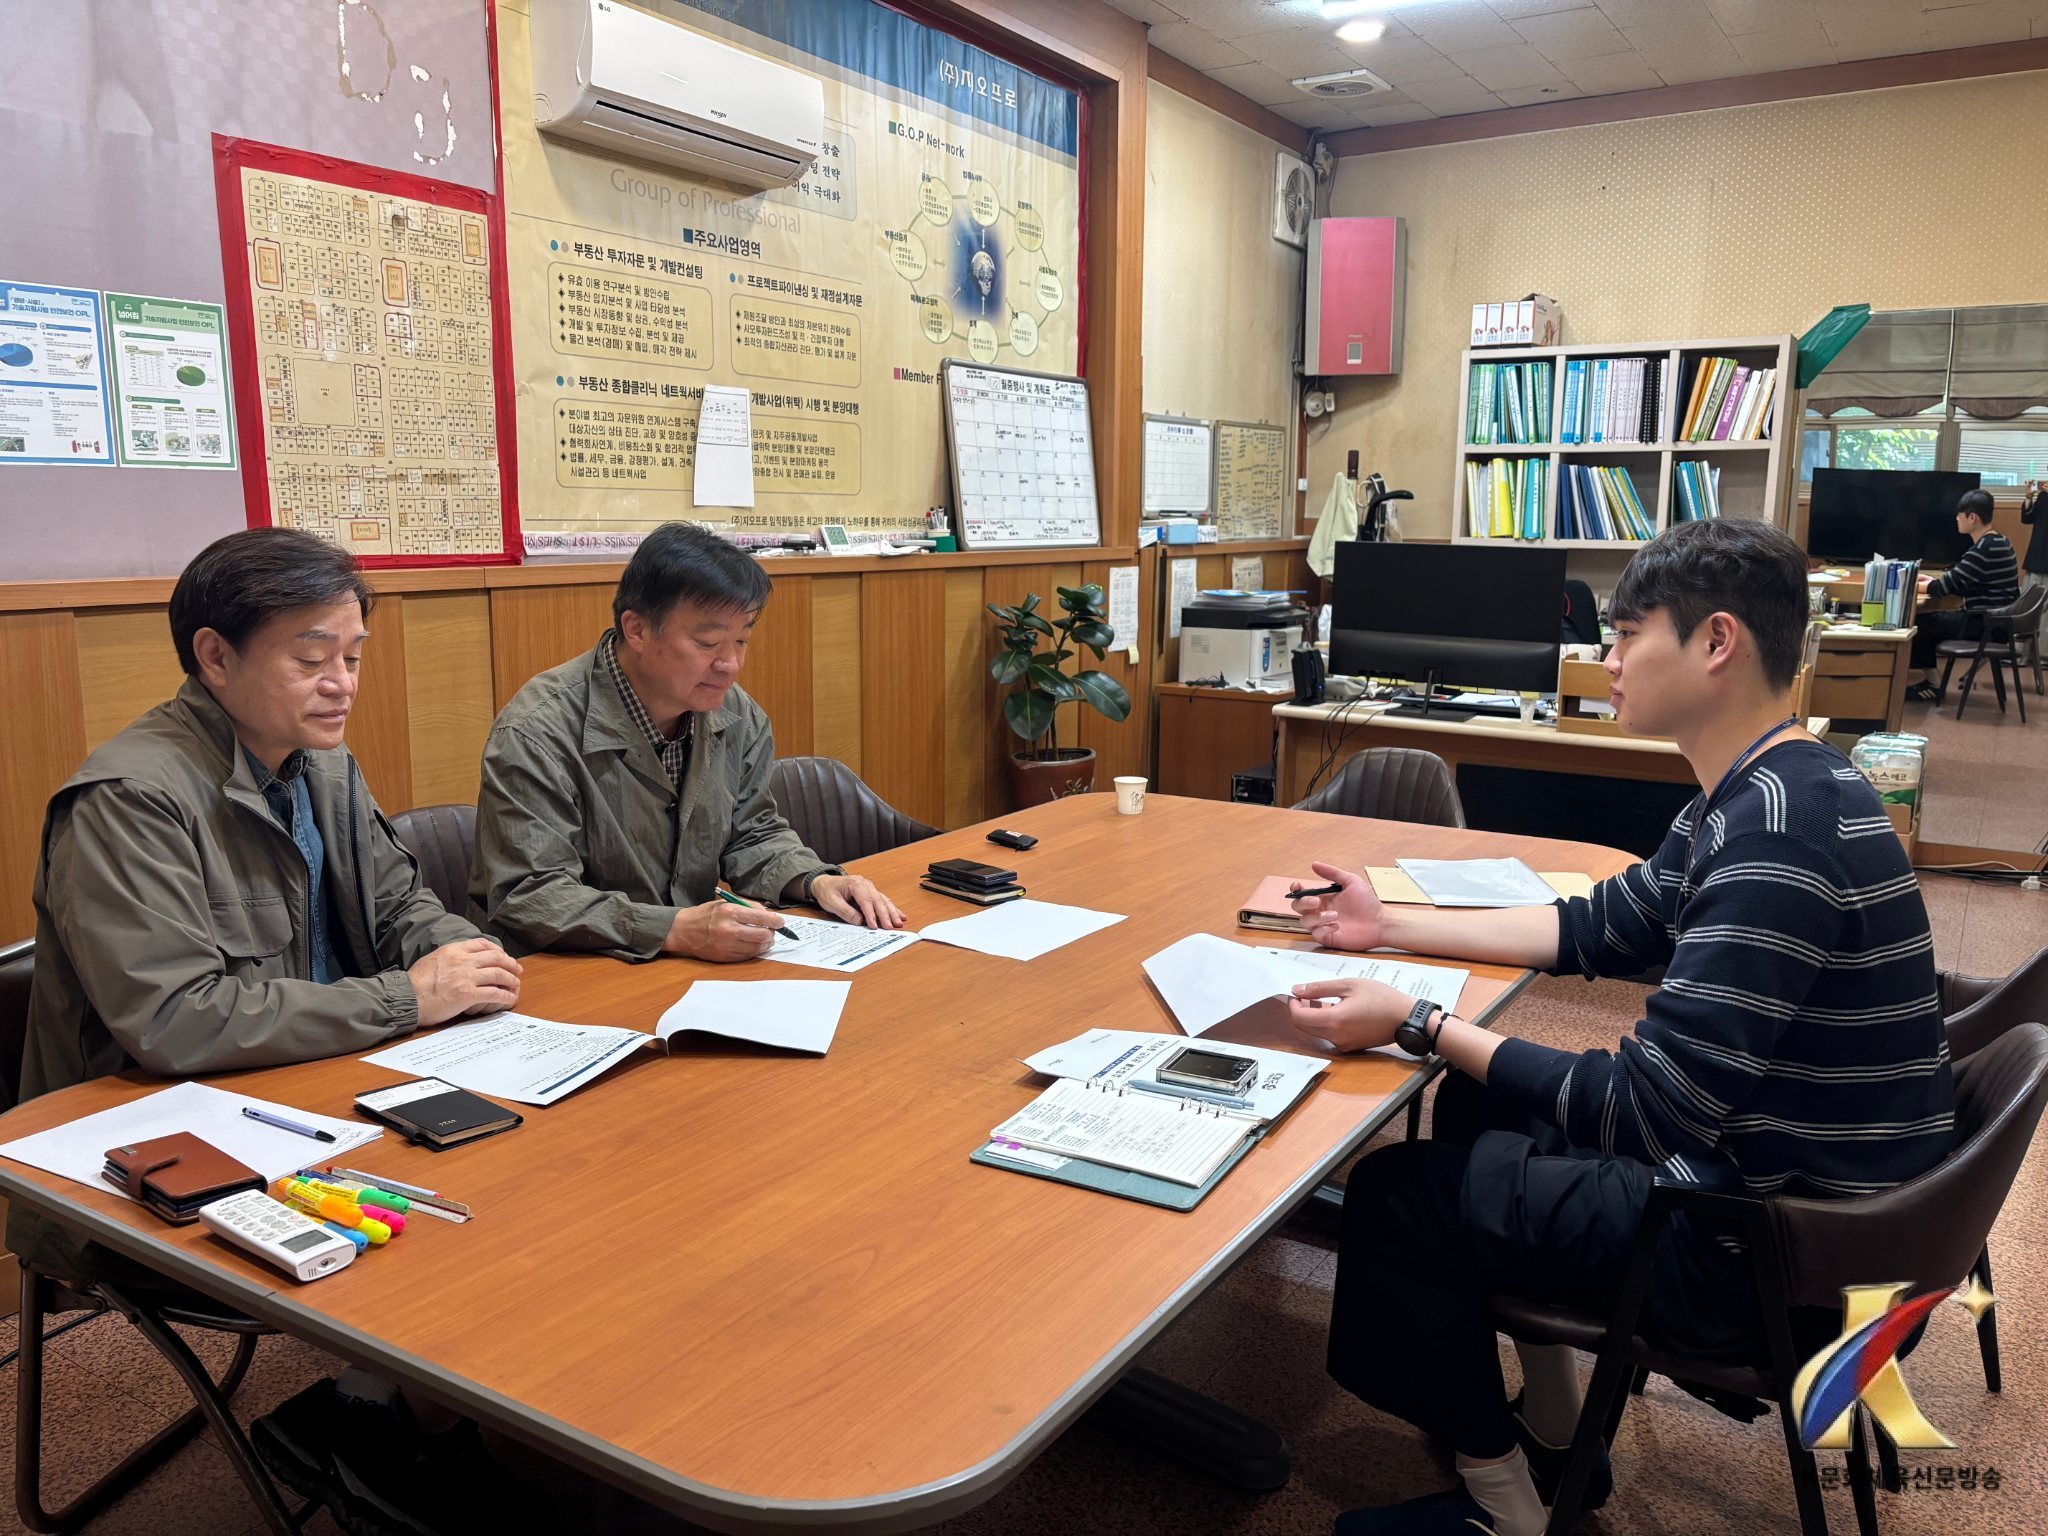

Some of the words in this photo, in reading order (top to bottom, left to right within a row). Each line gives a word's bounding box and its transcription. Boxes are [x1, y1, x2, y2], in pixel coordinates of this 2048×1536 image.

[940, 58, 1017, 109] (주)지오프로
[897, 123, 924, 143] G.O.P
[926, 133, 965, 158] Net-work
[821, 142, 840, 158] 창출
[822, 165, 841, 181] 전략
[609, 168, 672, 207] Group
[678, 188, 699, 209] of
[702, 190, 801, 233] Professional
[813, 185, 841, 203] 극대화
[694, 228, 761, 259] 주요사업영역
[573, 241, 604, 261] 부동산
[607, 248, 645, 269] 투자자문
[647, 256, 657, 272] 및
[659, 258, 703, 280] 개발컨설팅
[567, 274, 583, 287] 유효
[585, 276, 601, 290] 이용
[602, 280, 632, 295] 연구분석
[634, 285, 642, 297] 및
[643, 286, 670, 301] 방안수립
[747, 274, 809, 298] 프로젝트파이낸싱
[811, 286, 819, 299] 및
[820, 288, 863, 307] 재정설계자문
[568, 289, 591, 303] 부동산
[593, 293, 623, 307] 입지분석
[625, 297, 632, 309] 및
[634, 300, 648, 311] 사업
[650, 302, 671, 315] 타당성
[672, 306, 686, 317] 분석
[75, 310, 91, 318] OPL
[117, 310, 139, 320] 넘어짐
[568, 304, 591, 317] 부동산
[593, 308, 624, 322] 시장동향
[626, 312, 633, 323] 및
[652, 316, 673, 329] 수익성
[675, 320, 689, 331] 분석
[201, 321, 215, 329] OPL
[568, 318, 584, 331] 개발
[586, 321, 593, 332] 및
[596, 323, 627, 336] 투자정보
[646, 330, 660, 341] 분석
[662, 332, 669, 342] 및
[671, 332, 685, 344] 제공
[792, 331, 798, 341] 및
[569, 333, 584, 345] 물건
[586, 336, 623, 350] 분석(경매)
[626, 340, 633, 352] 및
[669, 345, 682, 357] 전략
[684, 348, 697, 359] 제시
[827, 348, 833, 358] 및
[901, 367, 934, 384] Member
[578, 375, 609, 392] 부동산
[611, 378, 658, 397] 종합클리닉
[660, 384, 704, 401] 네트웍서비
[1000, 378, 1025, 392] 월중행사
[1026, 382, 1033, 393] 및
[751, 392, 804, 410] 개발사업(위탁)
[806, 398, 821, 412] 시행
[822, 399, 830, 413] 및
[832, 401, 860, 416] 분양대행
[568, 409, 590, 421] 분야별
[592, 410, 615, 422] 최고의
[617, 412, 645, 425] 자문위원
[646, 414, 681, 427] 연계시스템
[568, 423, 606, 437] 대상자산의
[608, 426, 623, 438] 상태
[659, 429, 666, 441] 및
[765, 429, 772, 440] 및
[655, 442, 662, 453] 및
[664, 443, 685, 454] 합리적
[796, 444, 803, 454] 및
[589, 453, 608, 465] 세무,
[782, 456, 788, 466] 및
[570, 466, 600, 479] 시설관리
[602, 467, 610, 479] 등
[612, 467, 647, 480] 네트웍사업
[786, 468, 792, 479] 및
[731, 515, 768, 527] (주)지오프로
[898, 517, 928, 528] 사업성공파트
